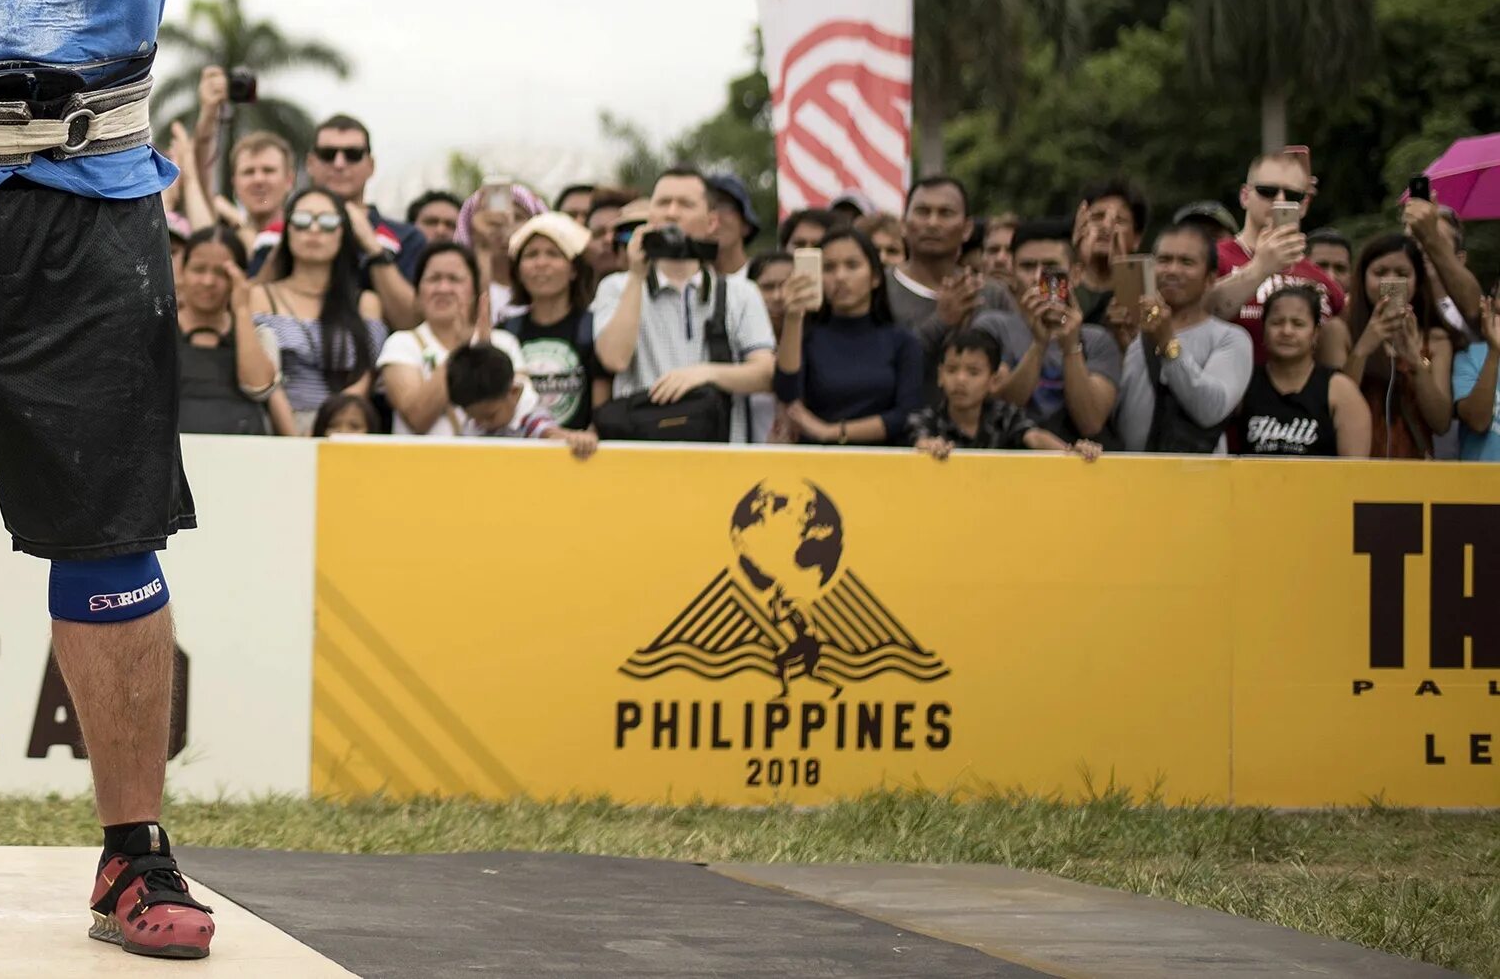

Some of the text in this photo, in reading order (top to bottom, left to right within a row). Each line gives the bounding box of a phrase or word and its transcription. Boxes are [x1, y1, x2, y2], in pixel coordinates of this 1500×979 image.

[89, 578, 162, 612] STRONG
[1353, 502, 1500, 670] TA
[615, 701, 952, 750] PHILIPPINES
[1425, 733, 1493, 764] LE
[746, 758, 821, 787] 2018
